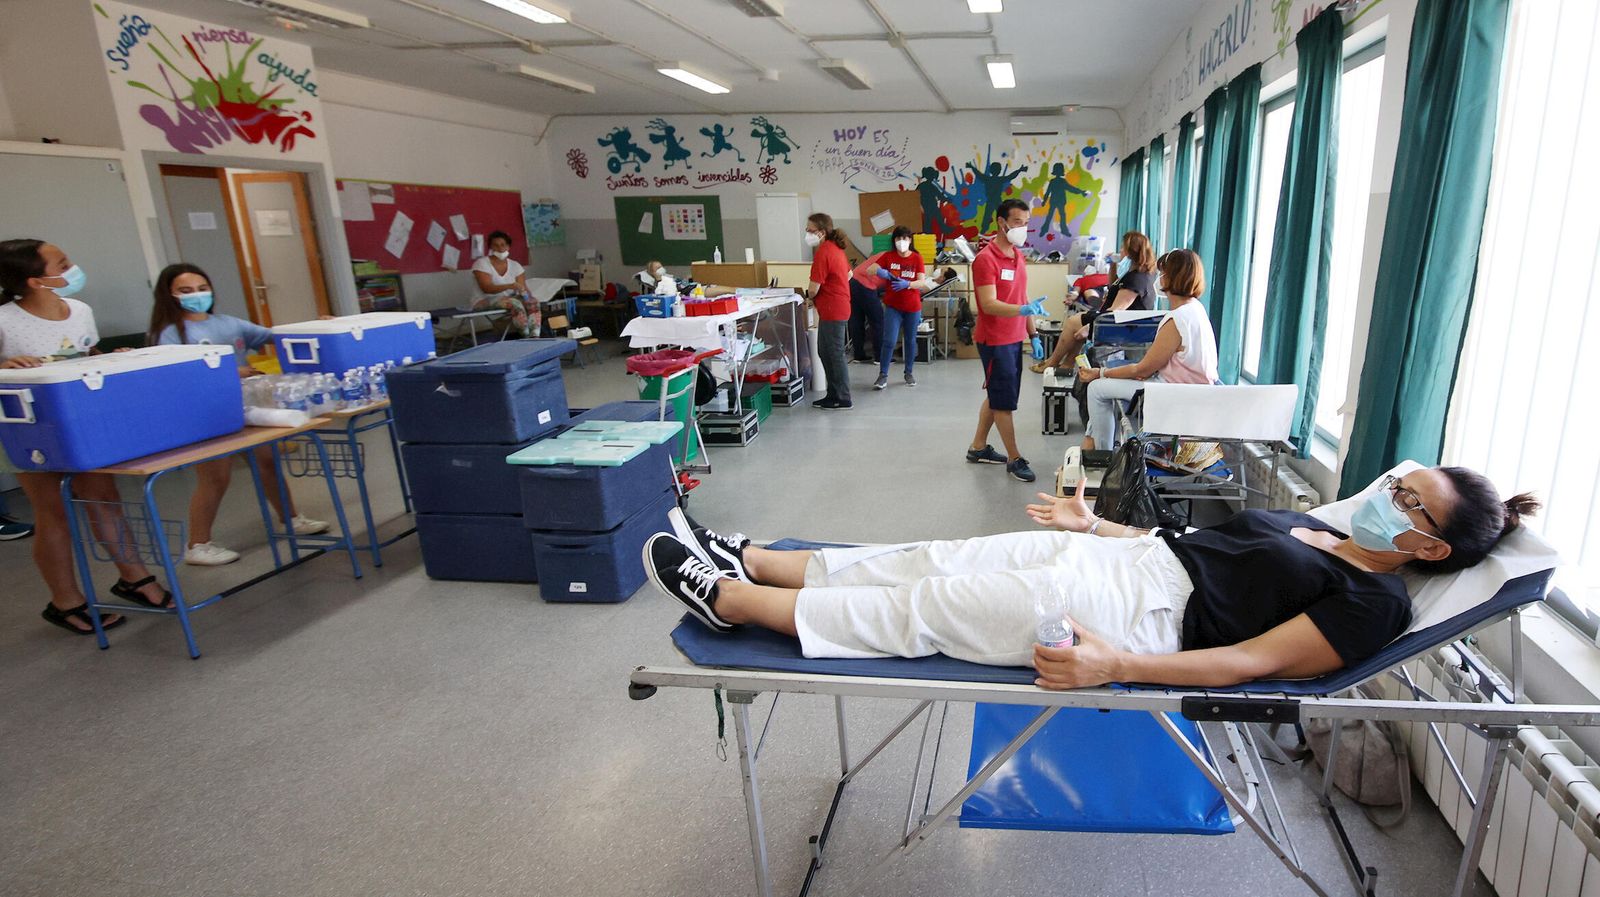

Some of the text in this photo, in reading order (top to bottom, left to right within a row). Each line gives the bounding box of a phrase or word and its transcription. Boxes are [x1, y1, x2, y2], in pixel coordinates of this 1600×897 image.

[257, 52, 319, 97] ayuda
[833, 126, 889, 144] HOY ES
[825, 143, 900, 158] un buen día
[606, 167, 753, 191] Juntos somos invencibles
